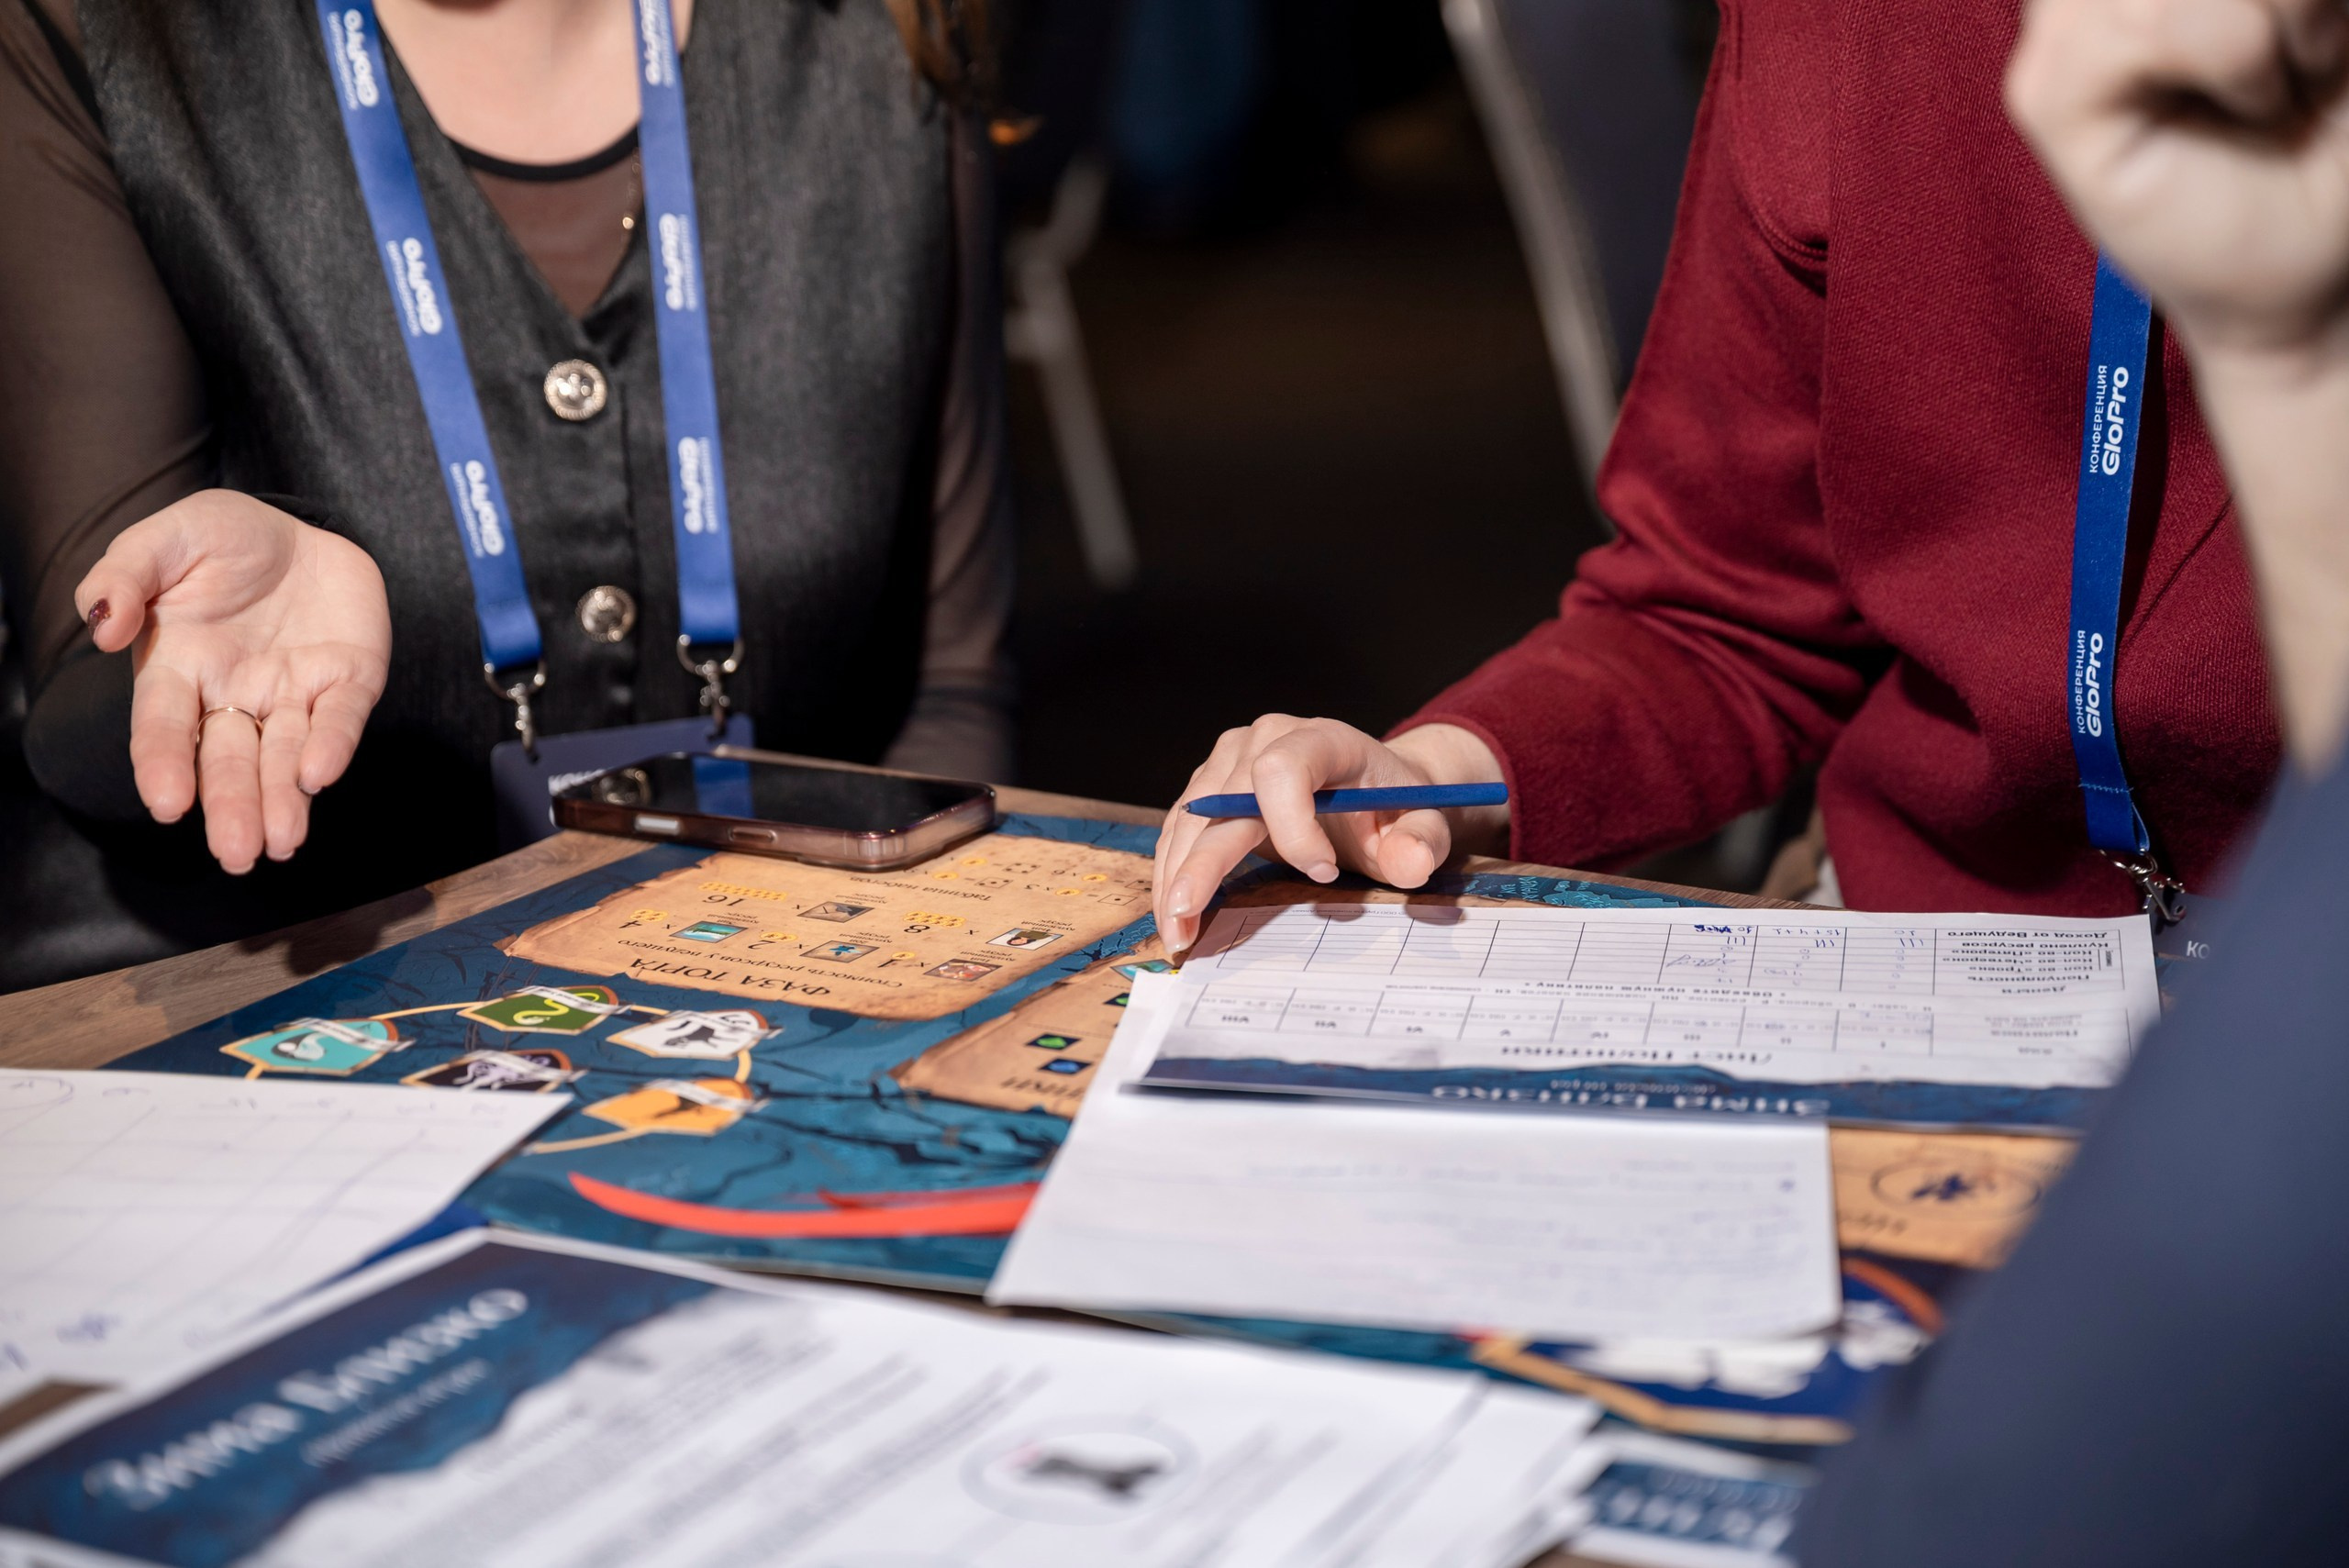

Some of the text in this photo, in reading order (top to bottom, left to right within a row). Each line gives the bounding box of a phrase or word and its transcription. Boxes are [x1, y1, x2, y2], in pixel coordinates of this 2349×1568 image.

[2089, 365, 2108, 473] КОНФЕРЕНЦИЯ
[2101, 367, 2129, 475] GloPro
[2076, 630, 2087, 734] КОНФЕРЕНЦИЯ
[2086, 633, 2103, 737] GloPro
[703, 895, 744, 906] 16
[619, 920, 642, 929] 4
[904, 924, 930, 934] 8
[618, 940, 701, 957] ведущего
[748, 940, 776, 950] 2
[719, 955, 805, 972] ресурсов
[878, 959, 899, 968] 1
[630, 958, 829, 996] ФАЗА ТОРГА
[807, 969, 902, 988] Стоимость
